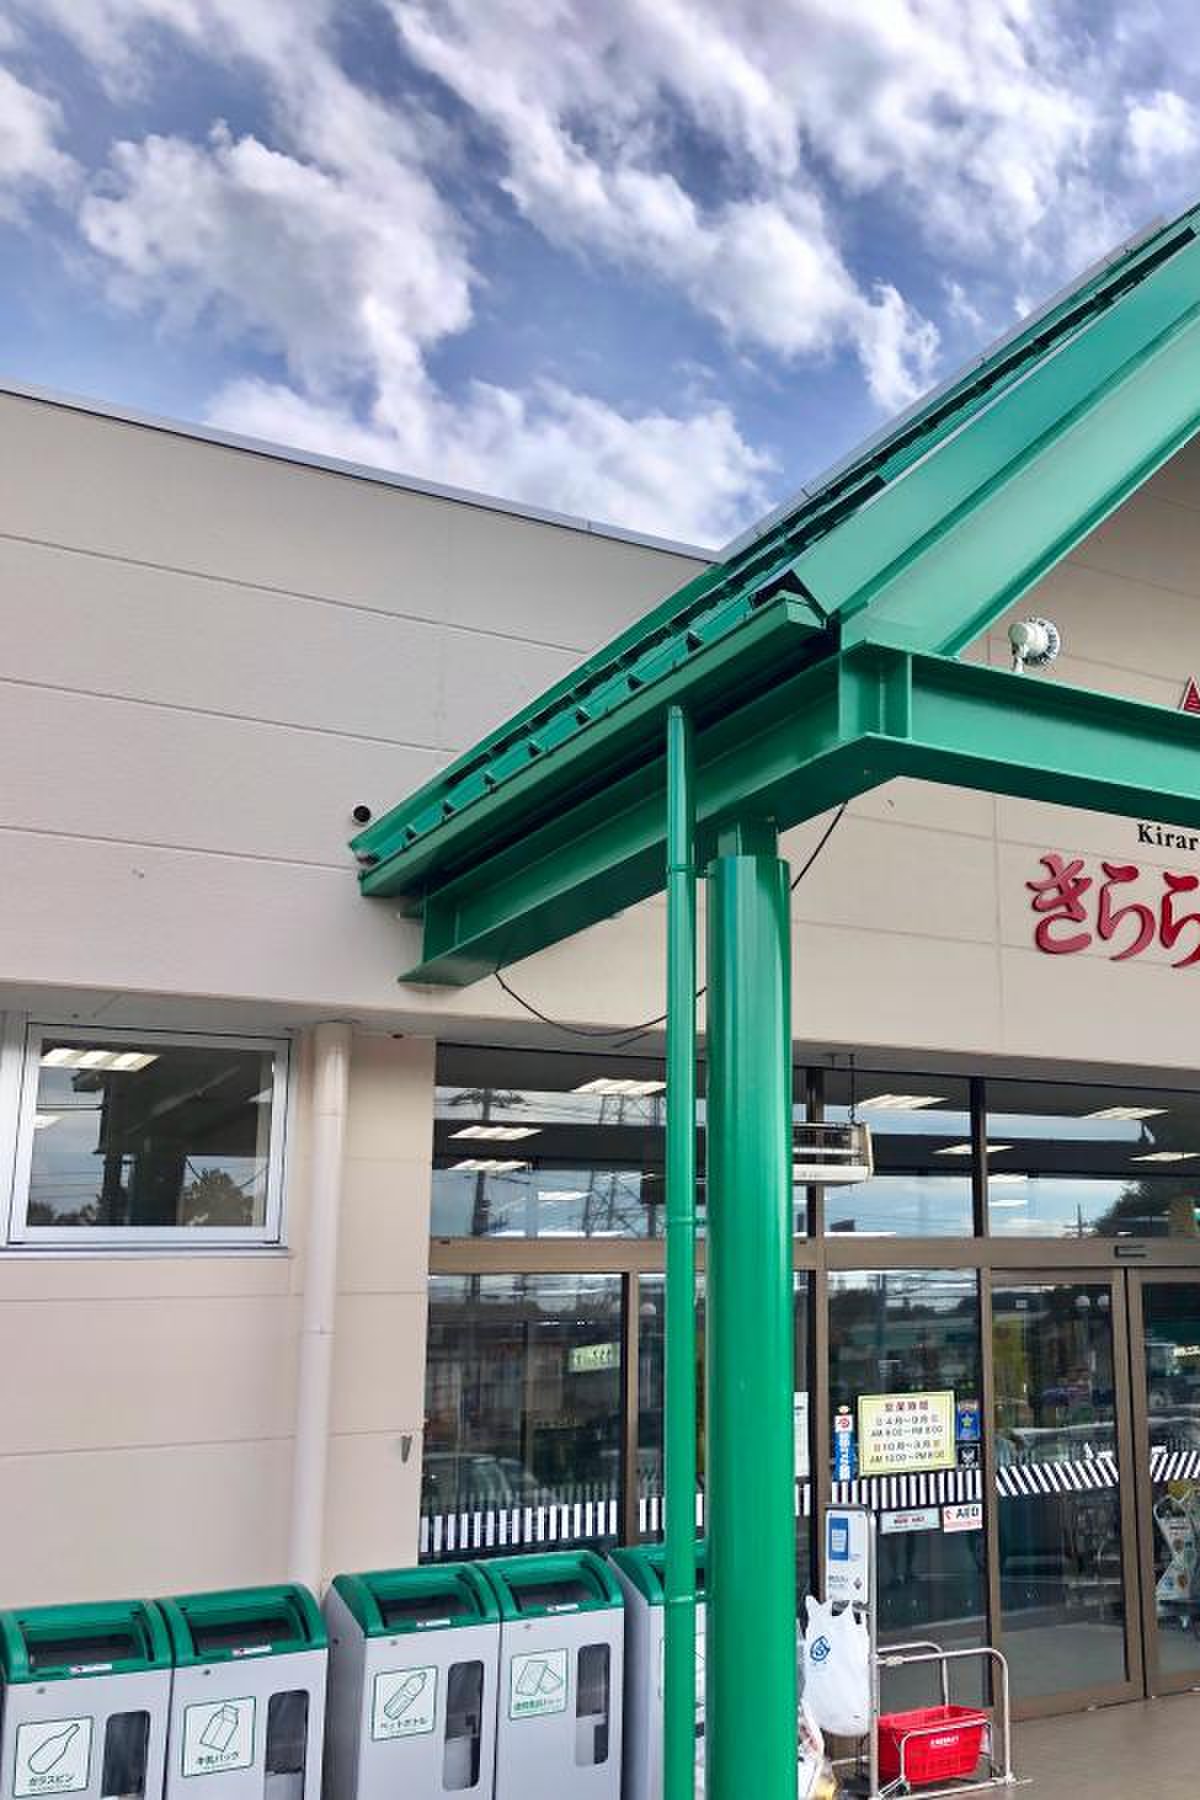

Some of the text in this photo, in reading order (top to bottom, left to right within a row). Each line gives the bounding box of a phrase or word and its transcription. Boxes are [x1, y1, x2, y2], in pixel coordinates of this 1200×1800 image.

[380, 1717, 428, 1730] ペットボトル
[197, 1752, 239, 1766] 牛乳パック
